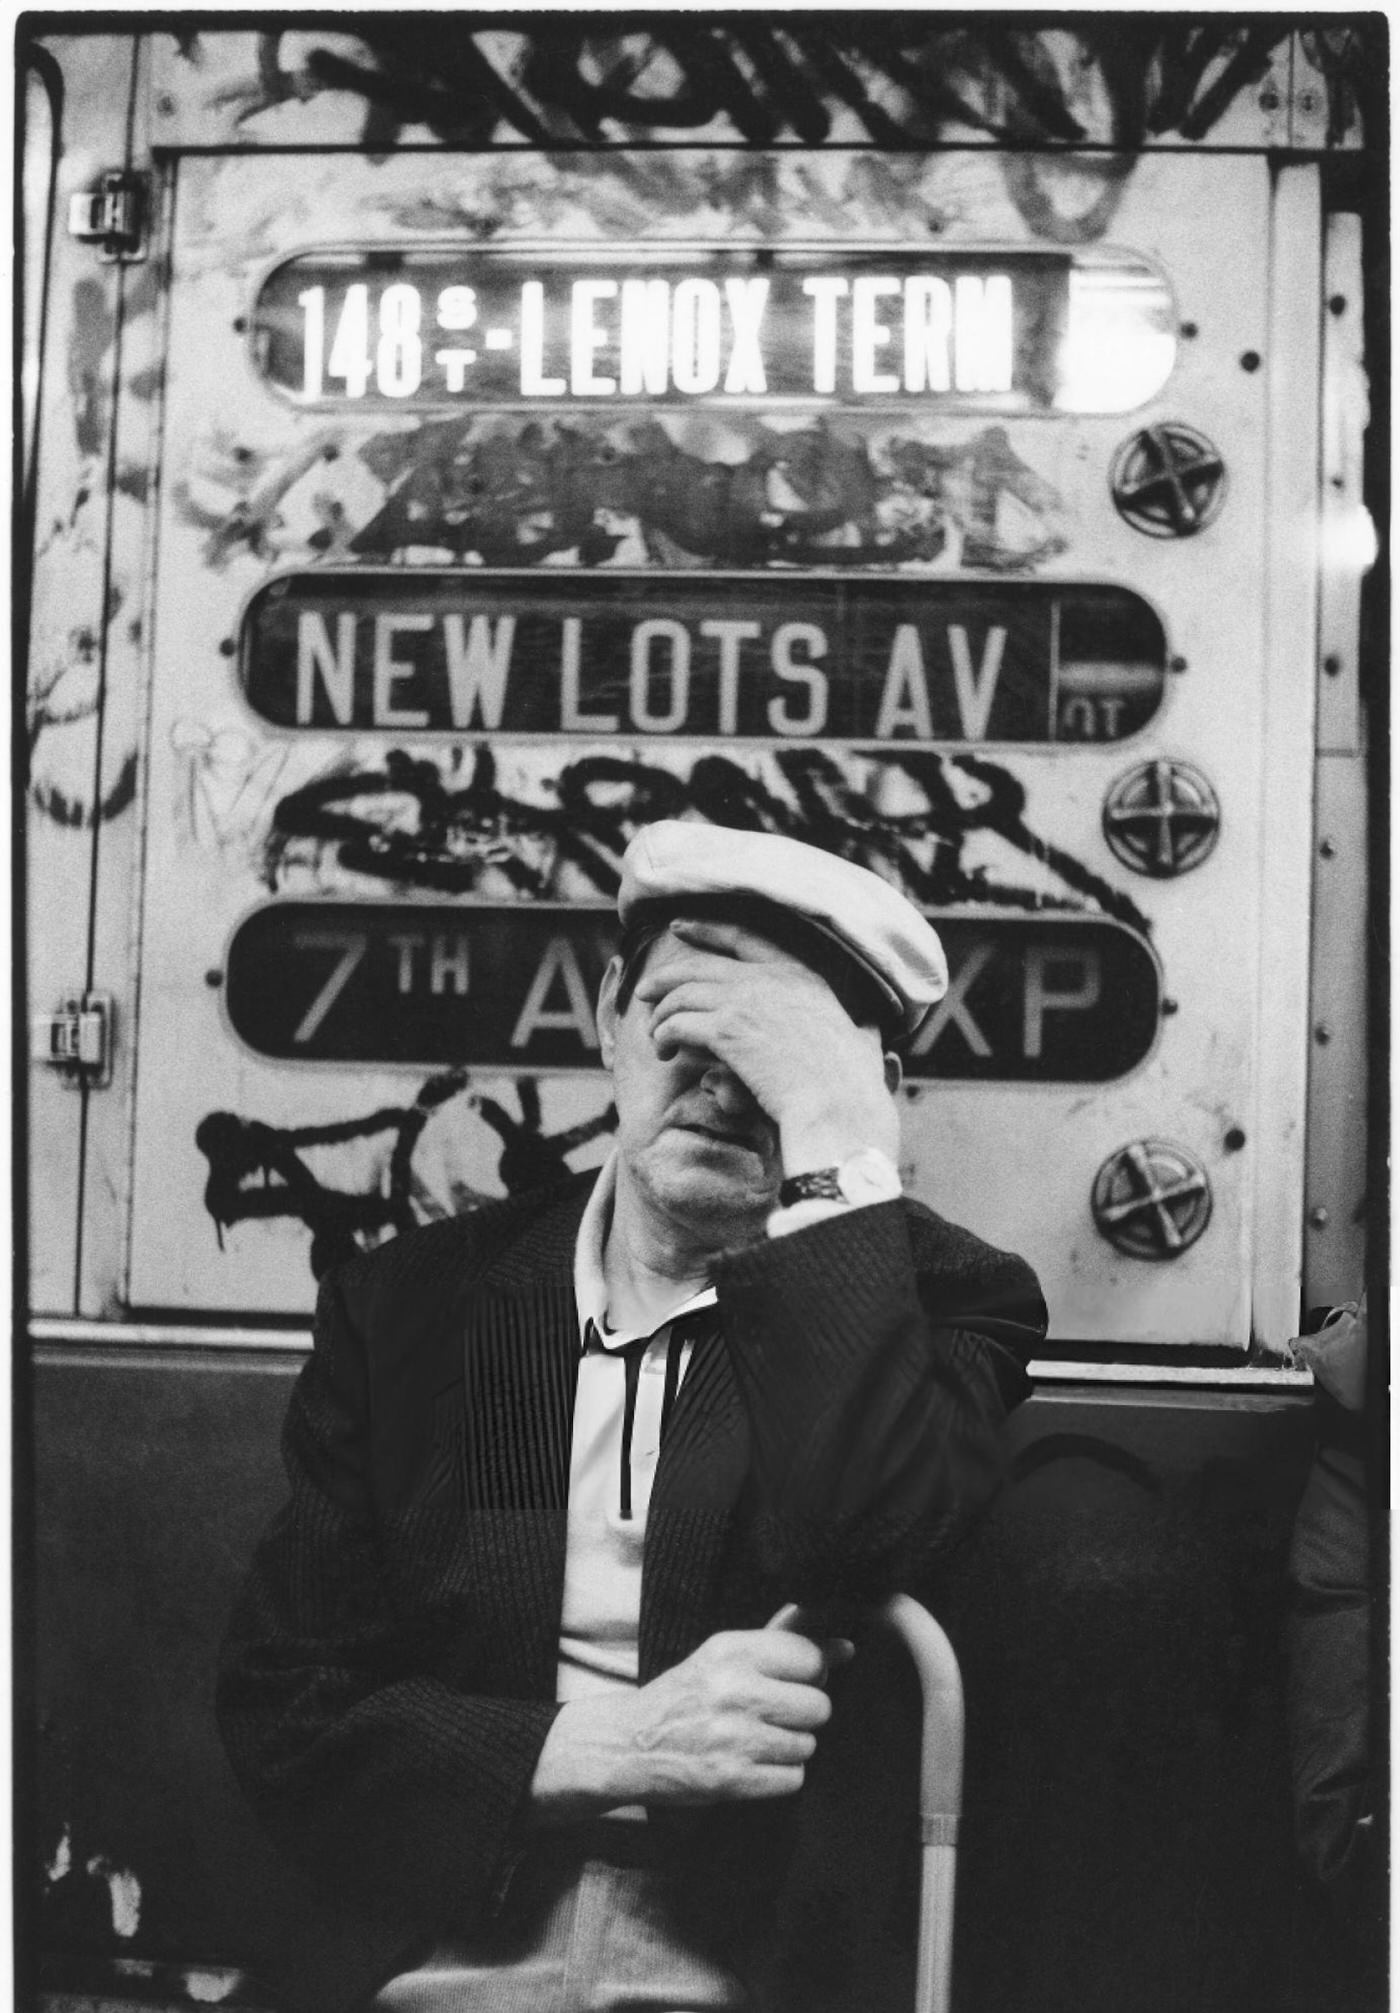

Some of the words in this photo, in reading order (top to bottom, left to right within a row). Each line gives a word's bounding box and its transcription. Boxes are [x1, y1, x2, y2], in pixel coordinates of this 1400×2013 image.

[803, 275, 1013, 393] TERM
[297, 611, 516, 728] NEW
[561, 617, 828, 736] LOTS
[875, 623, 1007, 740] AV
[510, 935, 614, 1048] A
